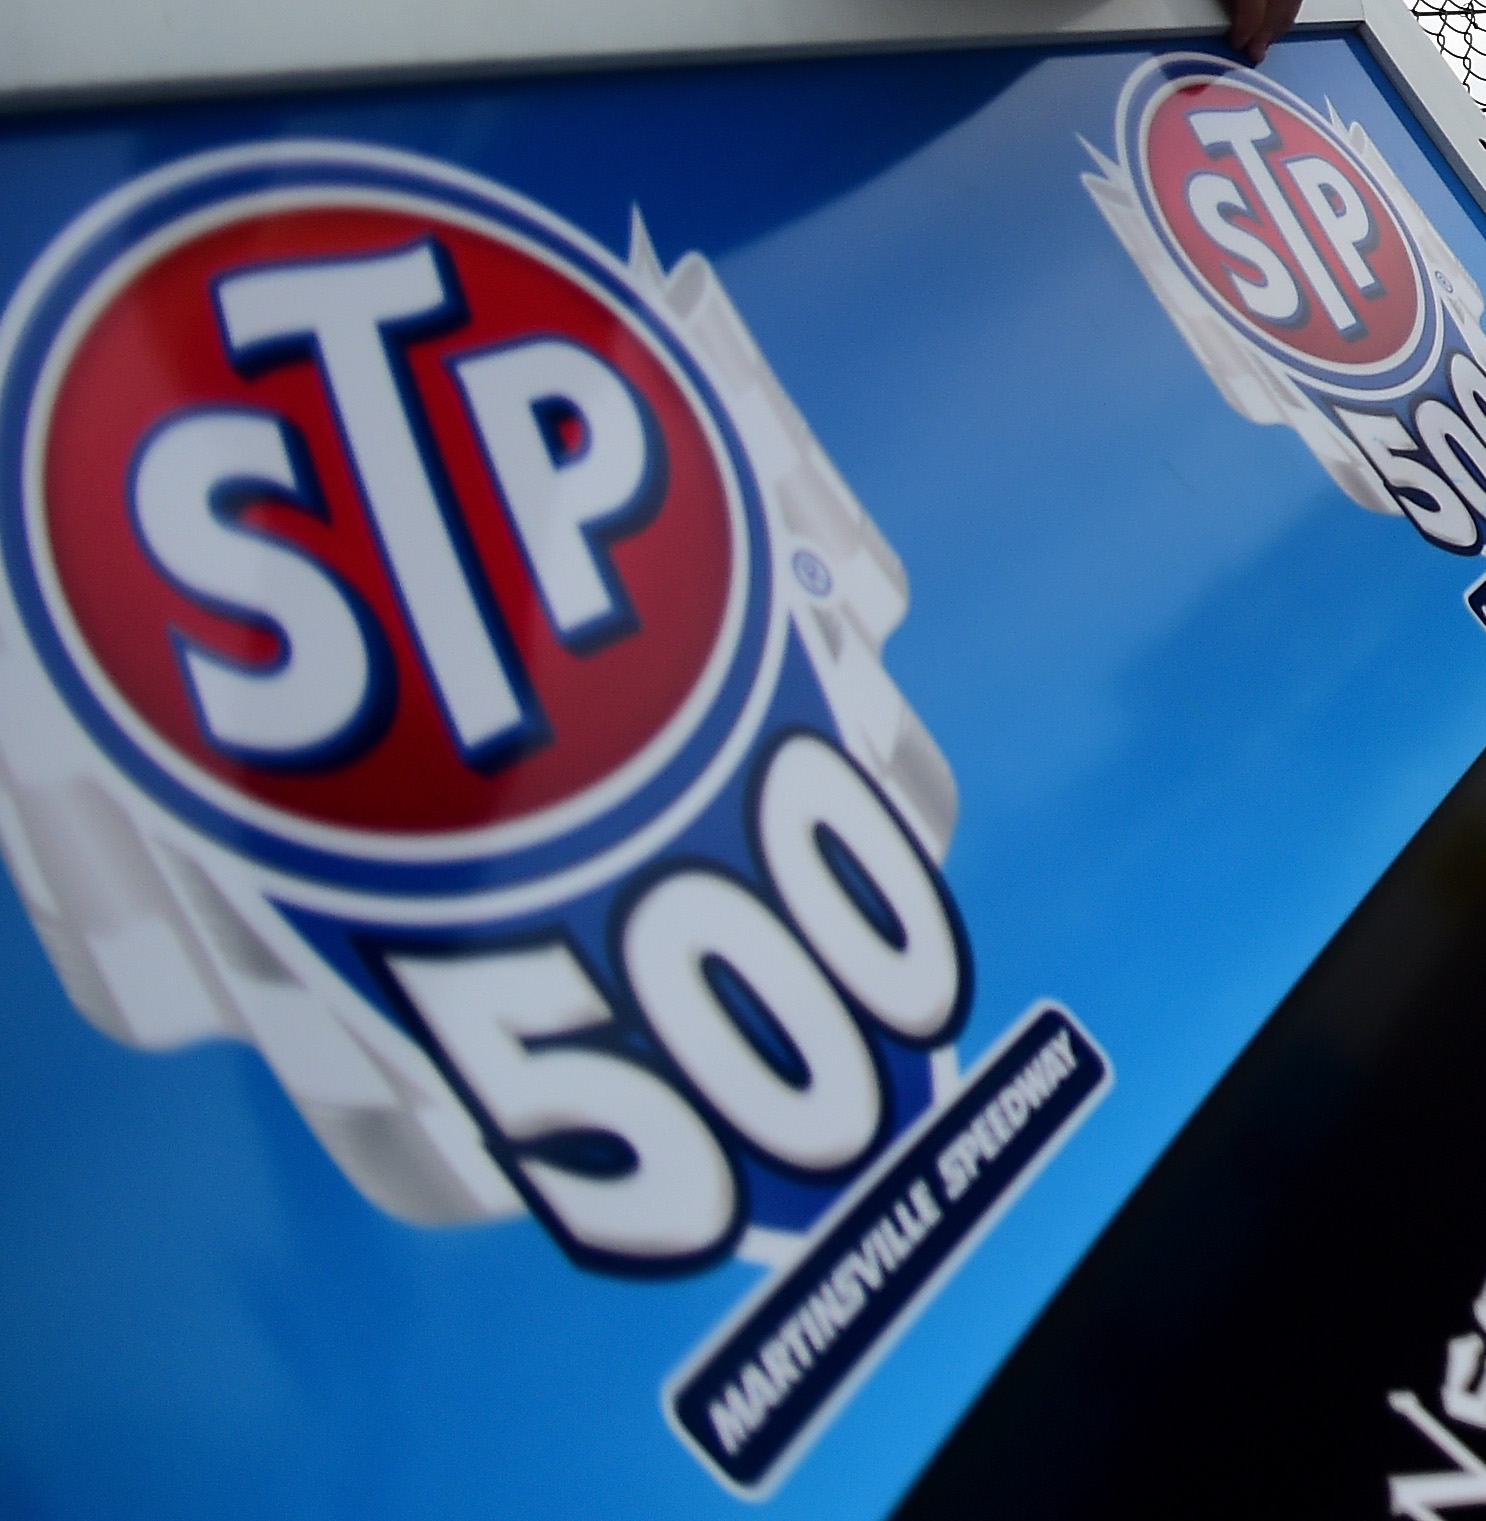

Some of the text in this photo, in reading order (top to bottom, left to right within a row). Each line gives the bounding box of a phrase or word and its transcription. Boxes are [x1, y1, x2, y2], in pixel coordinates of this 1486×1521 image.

[1187, 104, 1376, 335] STP
[131, 234, 668, 772] STP
[370, 728, 968, 1270] 500
[707, 1028, 1079, 1457] MARTINSVILLE SPEEDWAY
